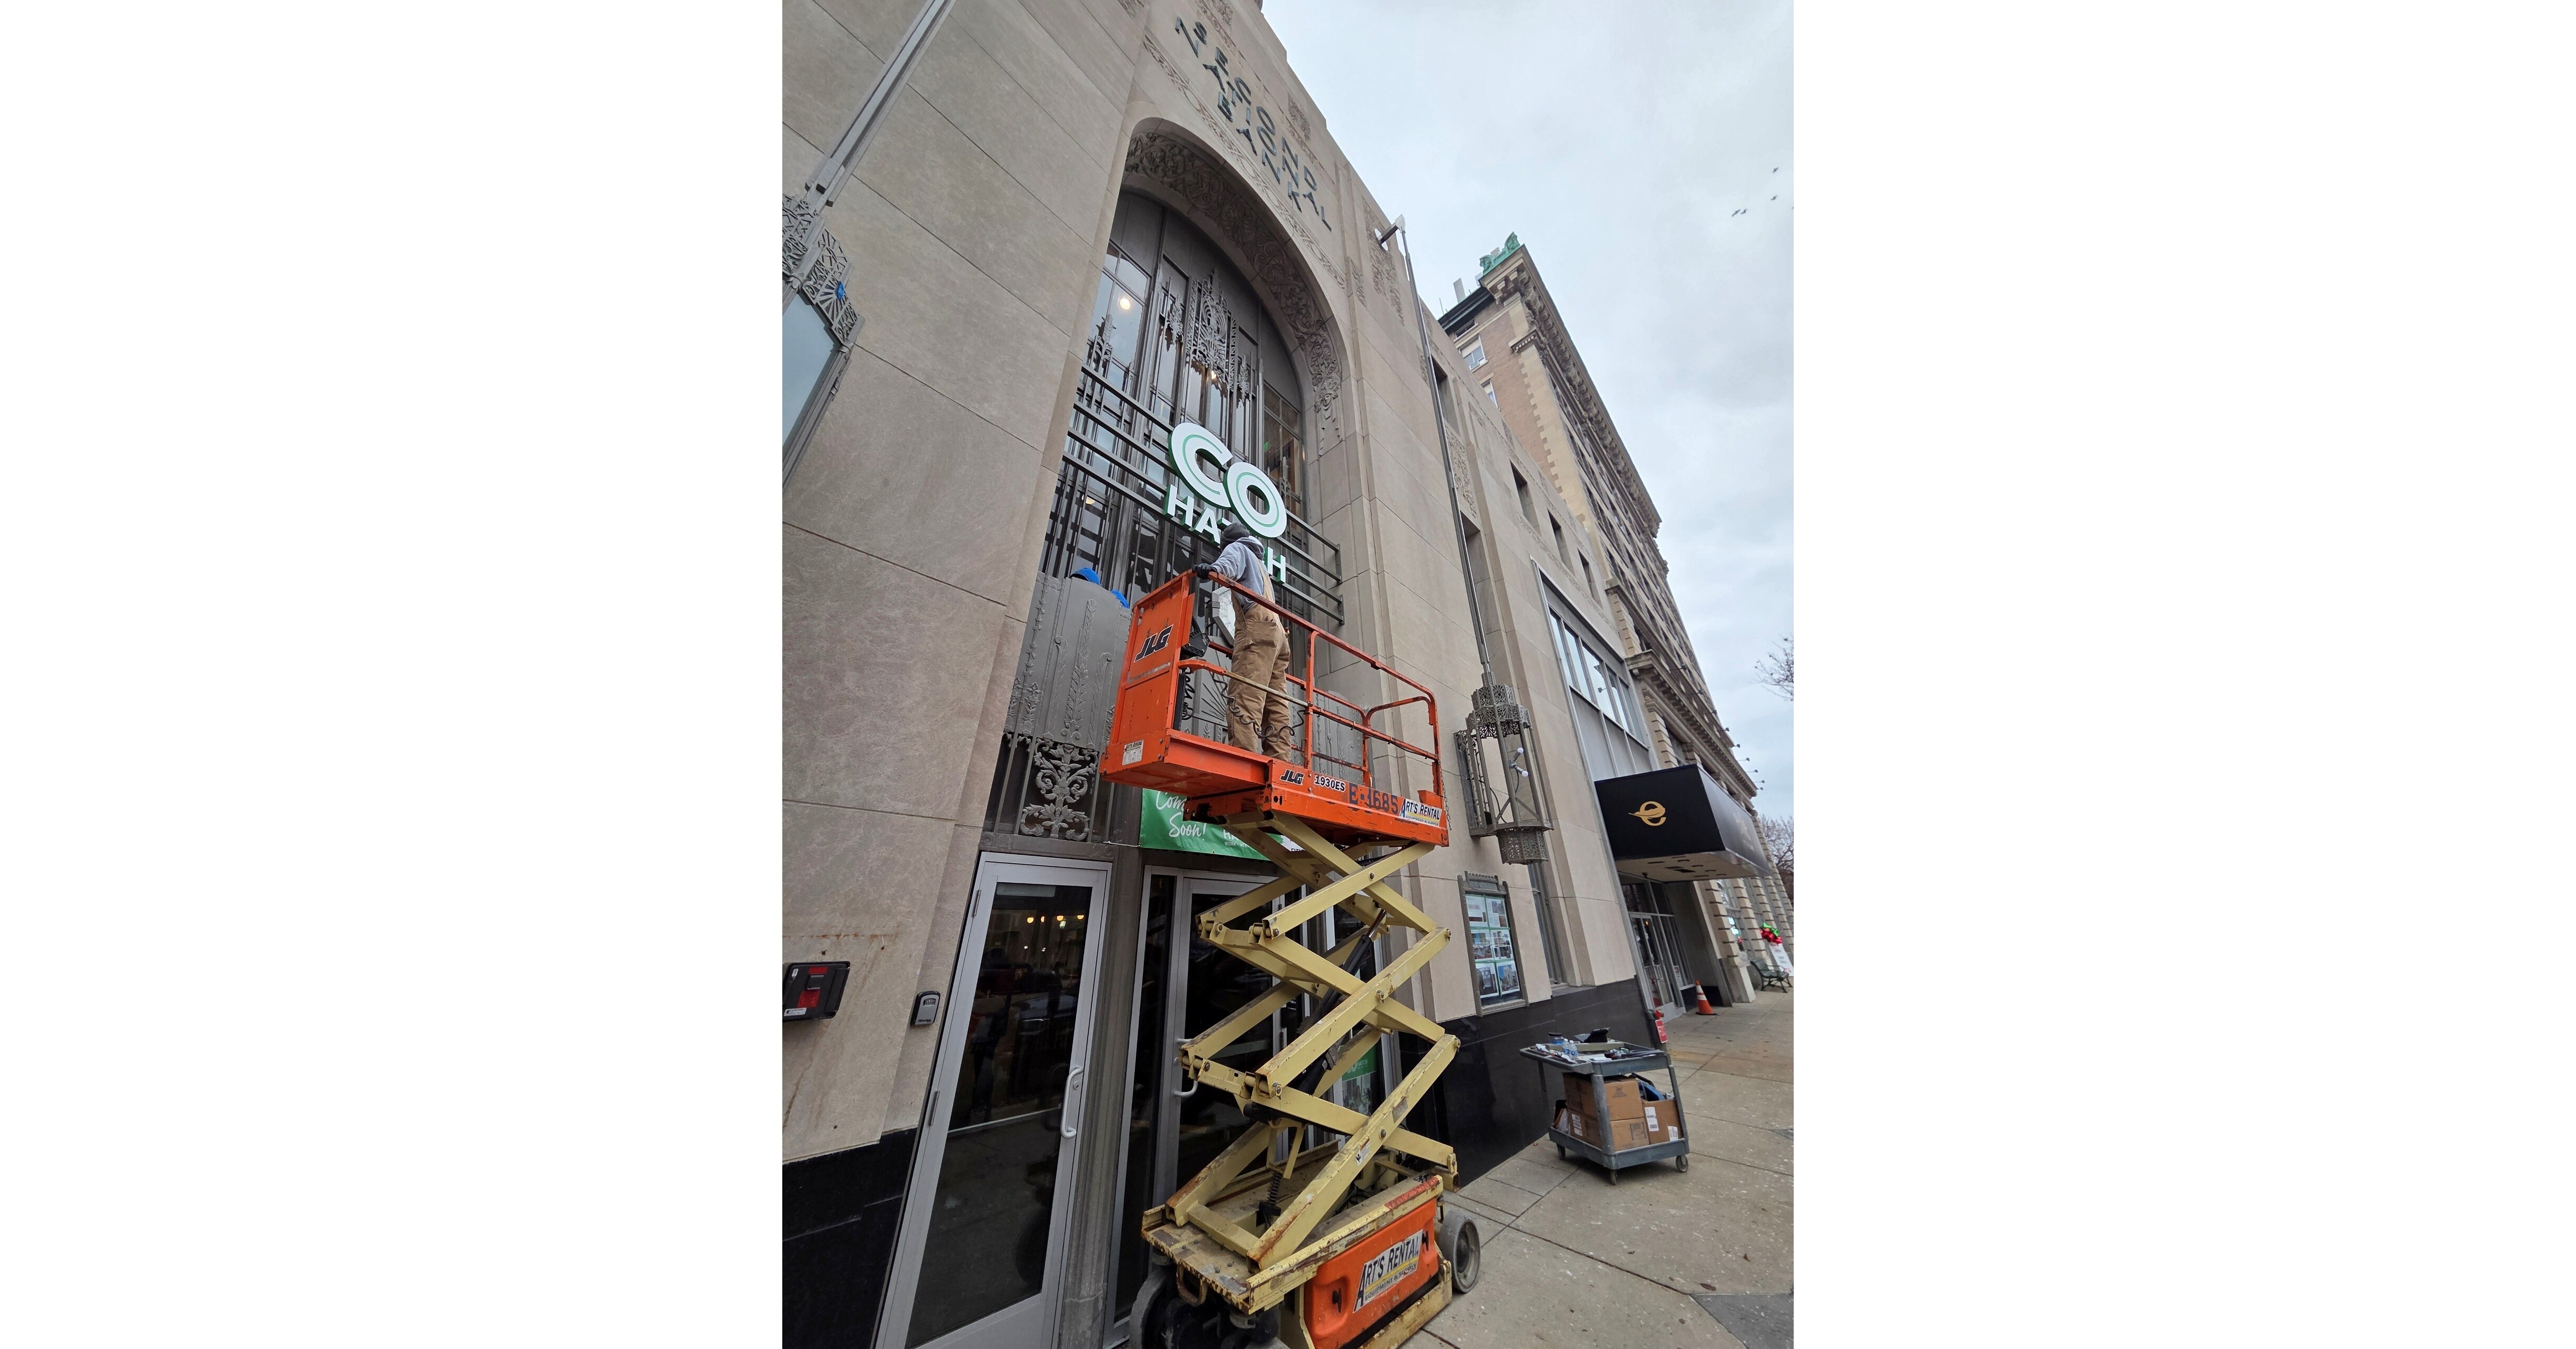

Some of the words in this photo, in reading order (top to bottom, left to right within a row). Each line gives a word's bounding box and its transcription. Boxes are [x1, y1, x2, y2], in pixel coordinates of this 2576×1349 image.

[1175, 16, 1332, 232] NATIONAL
[1193, 21, 1317, 191] SECOND
[1217, 92, 1302, 213] BANK
[1168, 422, 1287, 539] CO
[1164, 484, 1286, 584] HAH
[1134, 624, 1174, 663] JLG
[1280, 769, 1305, 786] JLG
[1314, 774, 1346, 793] 1930ES
[1168, 812, 1207, 841] Soon!
[1399, 798, 1418, 818] ART'S
[1420, 804, 1440, 820] RENTAL
[1354, 1255, 1385, 1313] ART'S
[1387, 1236, 1419, 1273] RENTAL
[1365, 1278, 1393, 1301] EQUIPMENT
[1399, 1262, 1417, 1277] SUPPLY
